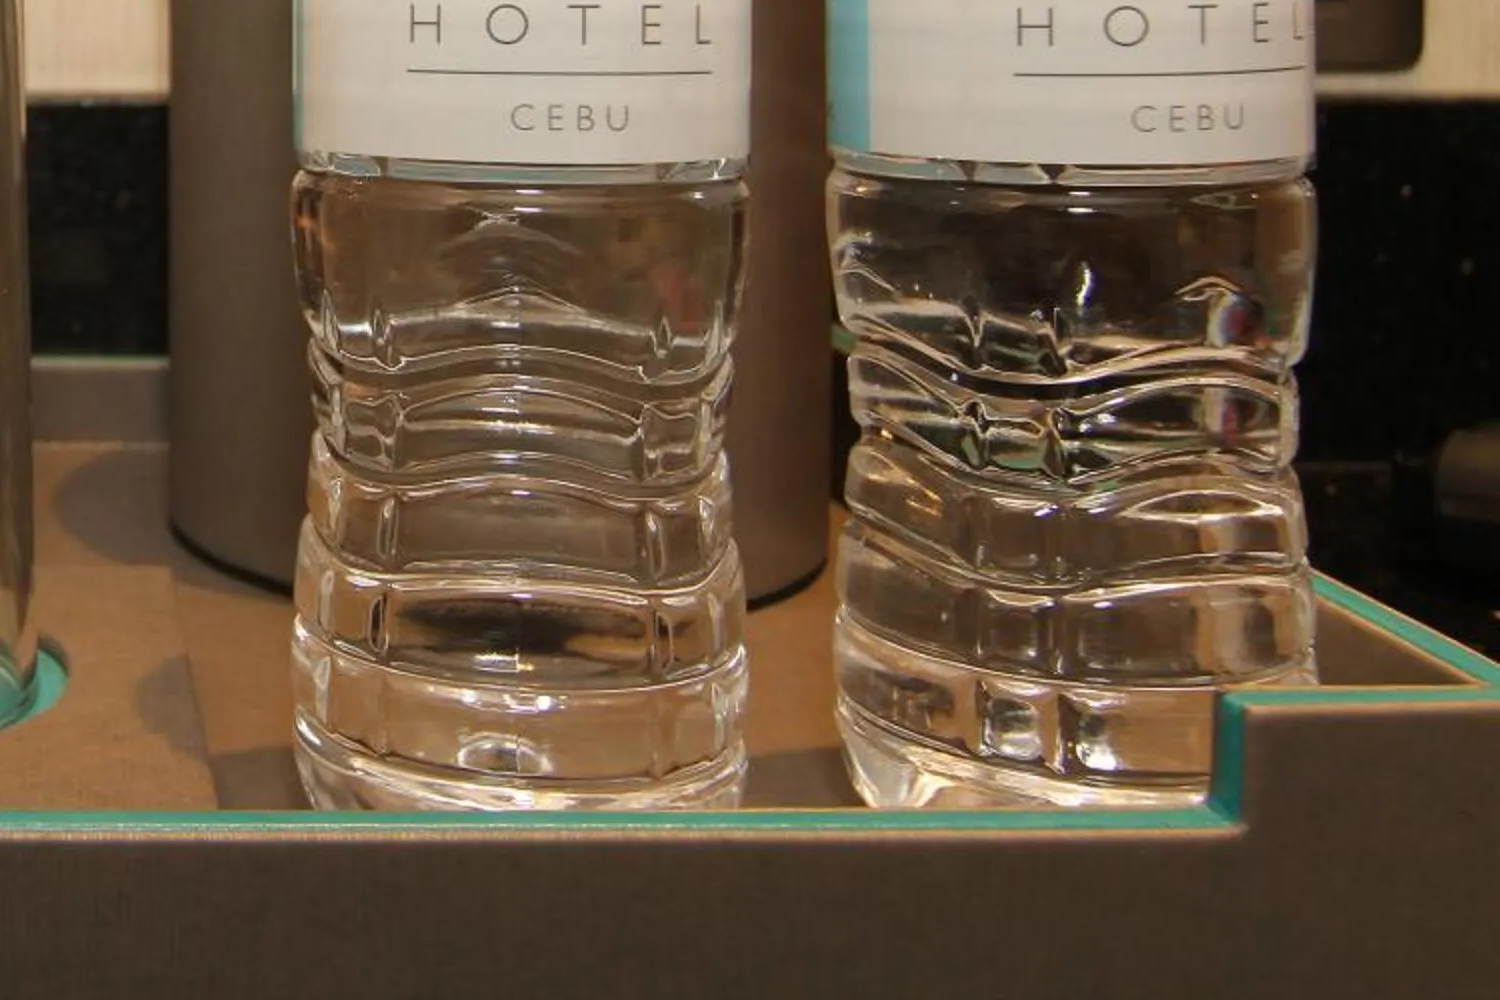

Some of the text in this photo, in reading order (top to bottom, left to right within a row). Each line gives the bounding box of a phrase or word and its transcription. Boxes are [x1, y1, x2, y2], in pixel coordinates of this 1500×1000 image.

[409, 3, 713, 46] HOTEL
[1016, 1, 1306, 47] HOTEL
[510, 102, 631, 132] CEBU
[1131, 103, 1246, 133] CEBU
